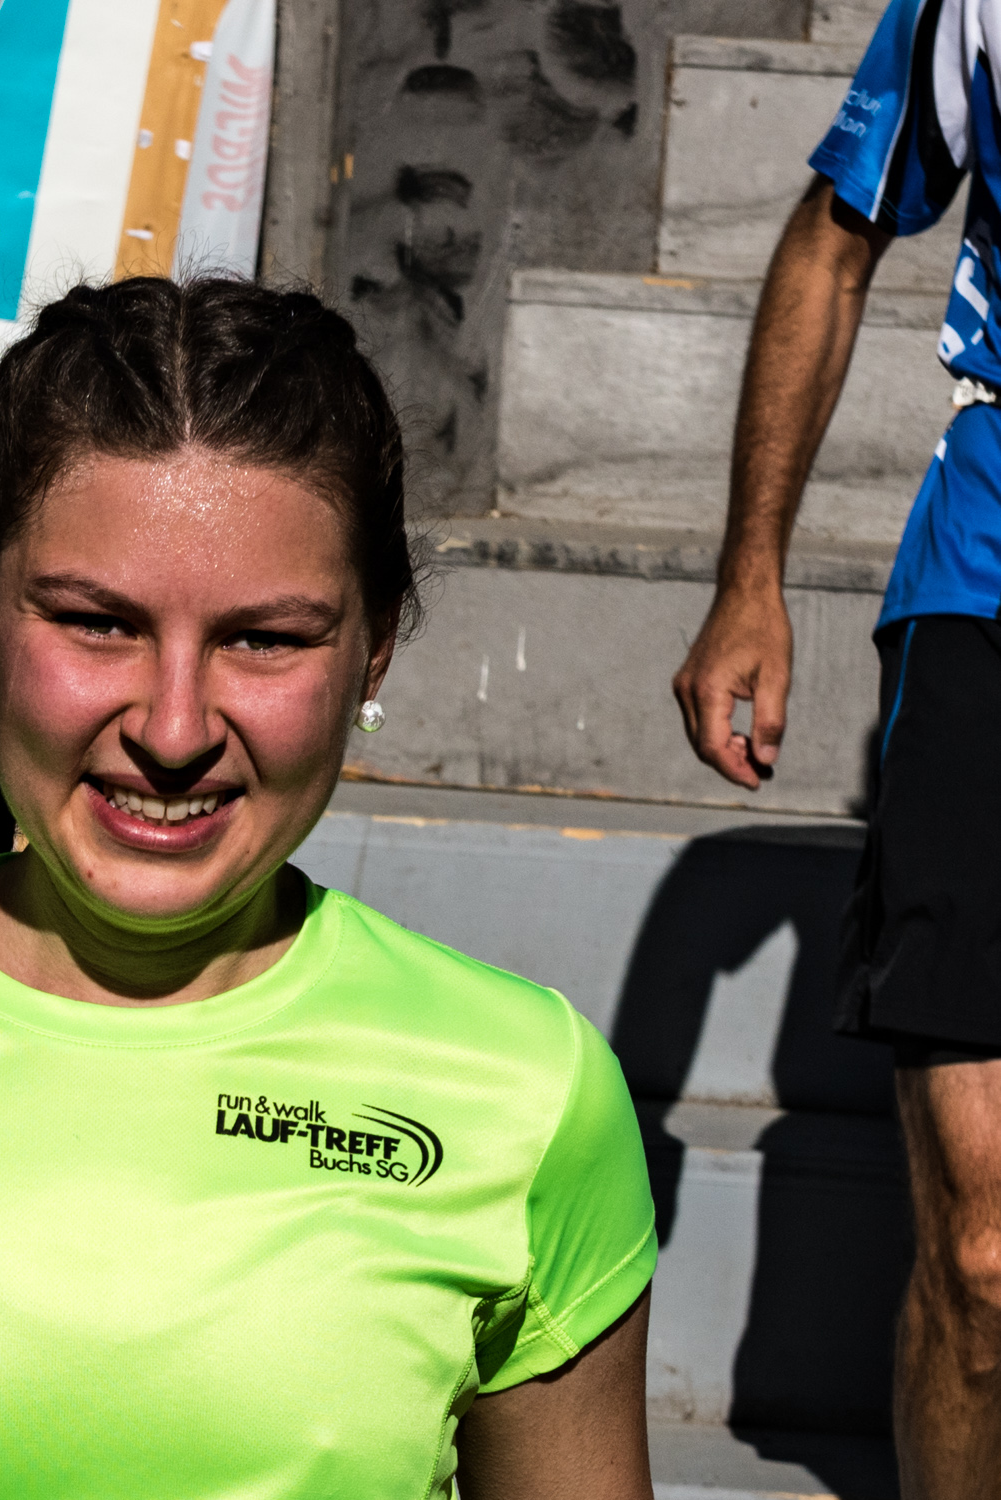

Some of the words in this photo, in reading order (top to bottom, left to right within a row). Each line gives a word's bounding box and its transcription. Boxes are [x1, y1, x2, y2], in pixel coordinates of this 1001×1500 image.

[218, 1094, 251, 1111] run
[255, 1095, 270, 1115] &
[273, 1100, 327, 1123] walk
[215, 1109, 401, 1160] LAUF-TREFF
[310, 1149, 371, 1175] Buchs
[376, 1159, 409, 1182] SG
